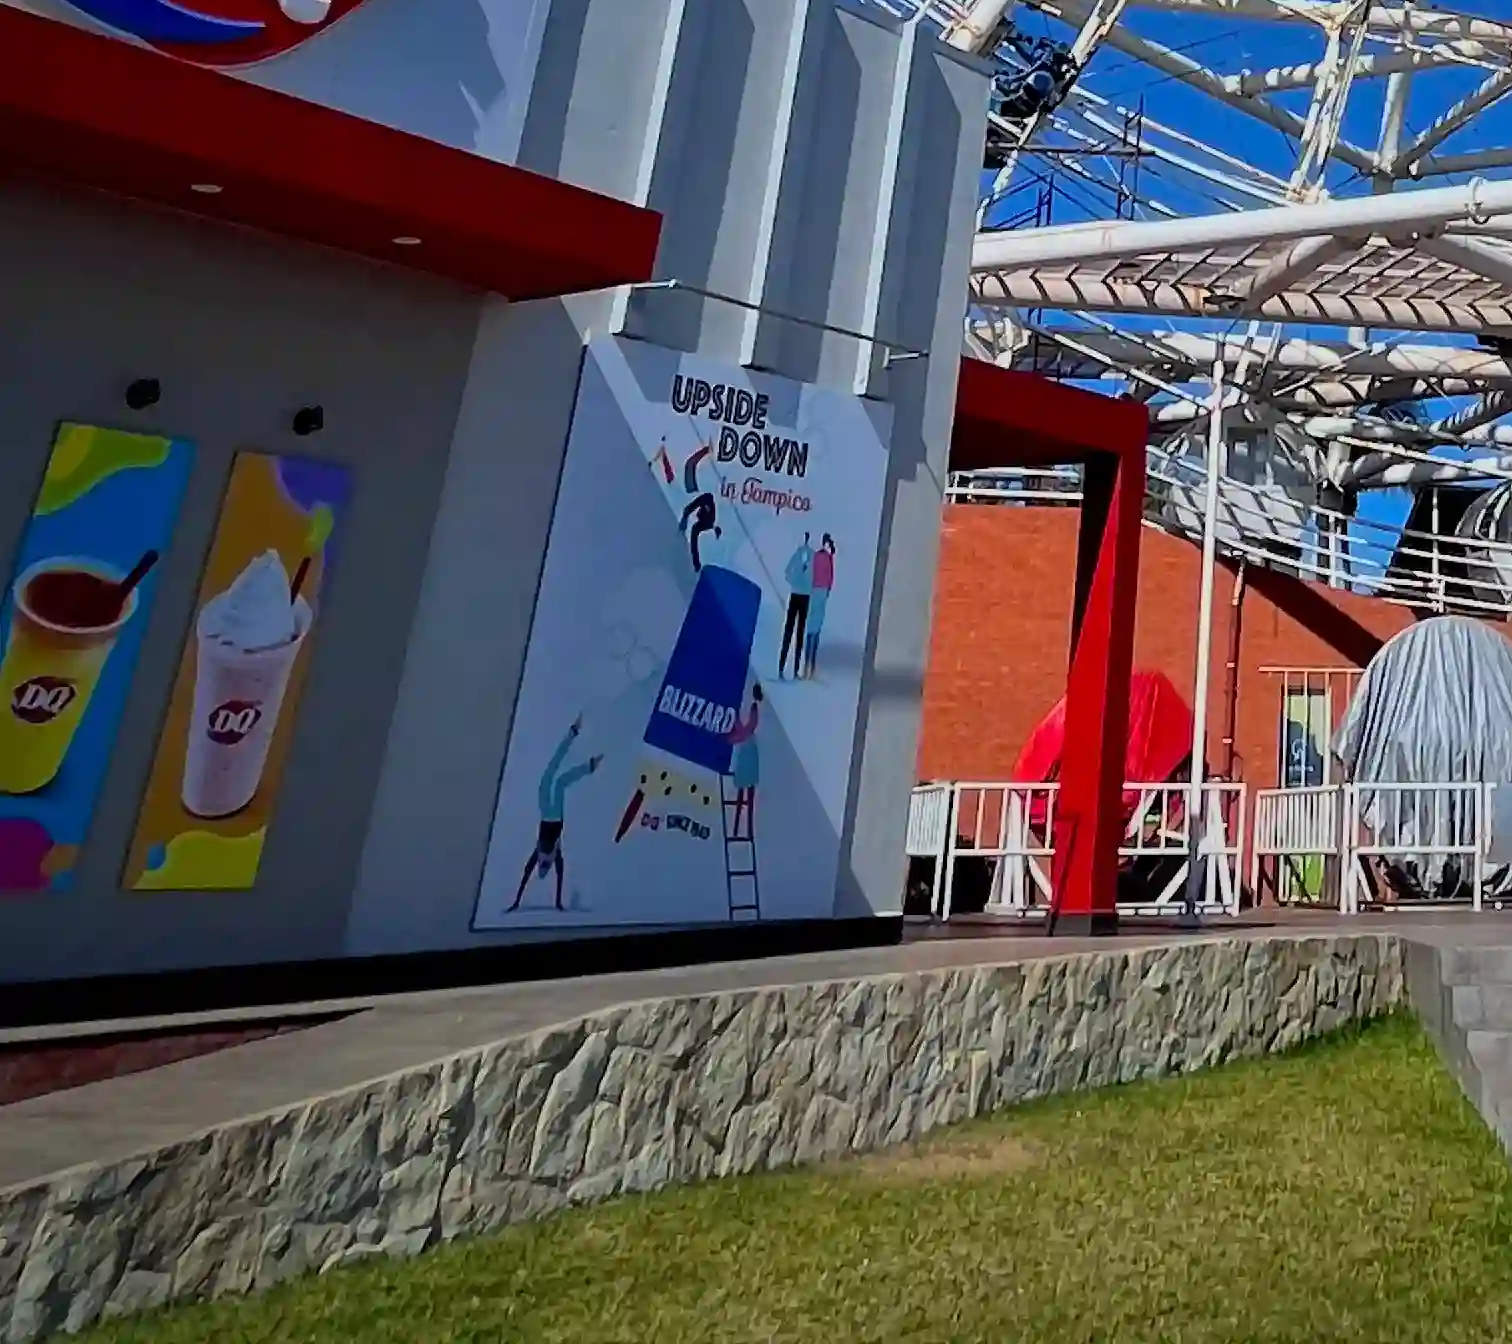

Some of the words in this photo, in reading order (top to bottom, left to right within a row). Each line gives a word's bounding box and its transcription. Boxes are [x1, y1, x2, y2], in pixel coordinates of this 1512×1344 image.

[671, 374, 769, 429] UPSIDE
[716, 426, 809, 477] DOWN
[741, 476, 811, 516] Tampico
[20, 683, 71, 713] DQ
[659, 684, 736, 734] BLIZZARD
[213, 708, 256, 734] DQ
